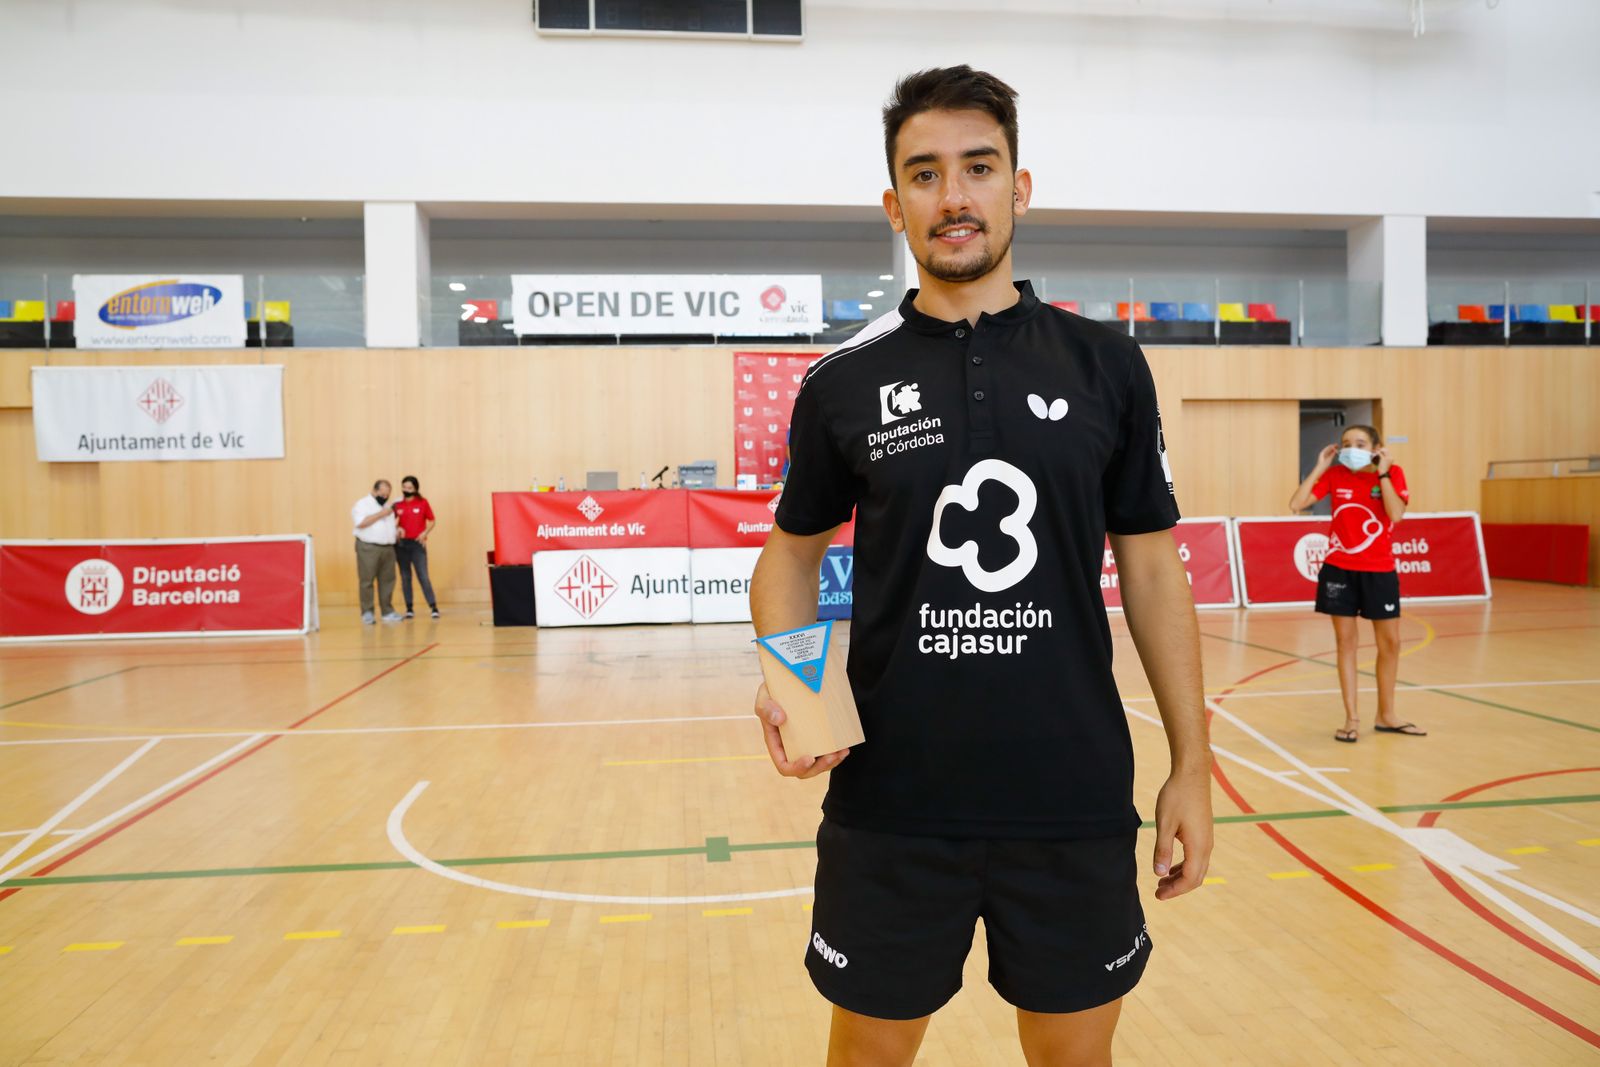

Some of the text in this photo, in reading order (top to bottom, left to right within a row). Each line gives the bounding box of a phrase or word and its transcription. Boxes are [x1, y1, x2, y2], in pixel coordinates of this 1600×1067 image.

[107, 288, 215, 316] entornweb
[528, 291, 740, 318] OPEN DE VIC
[91, 333, 232, 346] www.entornweb.com
[78, 431, 245, 454] Ajuntament de Vic
[868, 417, 941, 446] Diputación
[870, 433, 944, 461] de Córdoba
[537, 522, 646, 540] Ajuntament de Vic
[133, 564, 241, 587] Diputació
[132, 586, 240, 606] Barcelona
[919, 601, 1052, 629] fundación
[918, 627, 1028, 660] cajasur
[813, 932, 848, 969] GEWO
